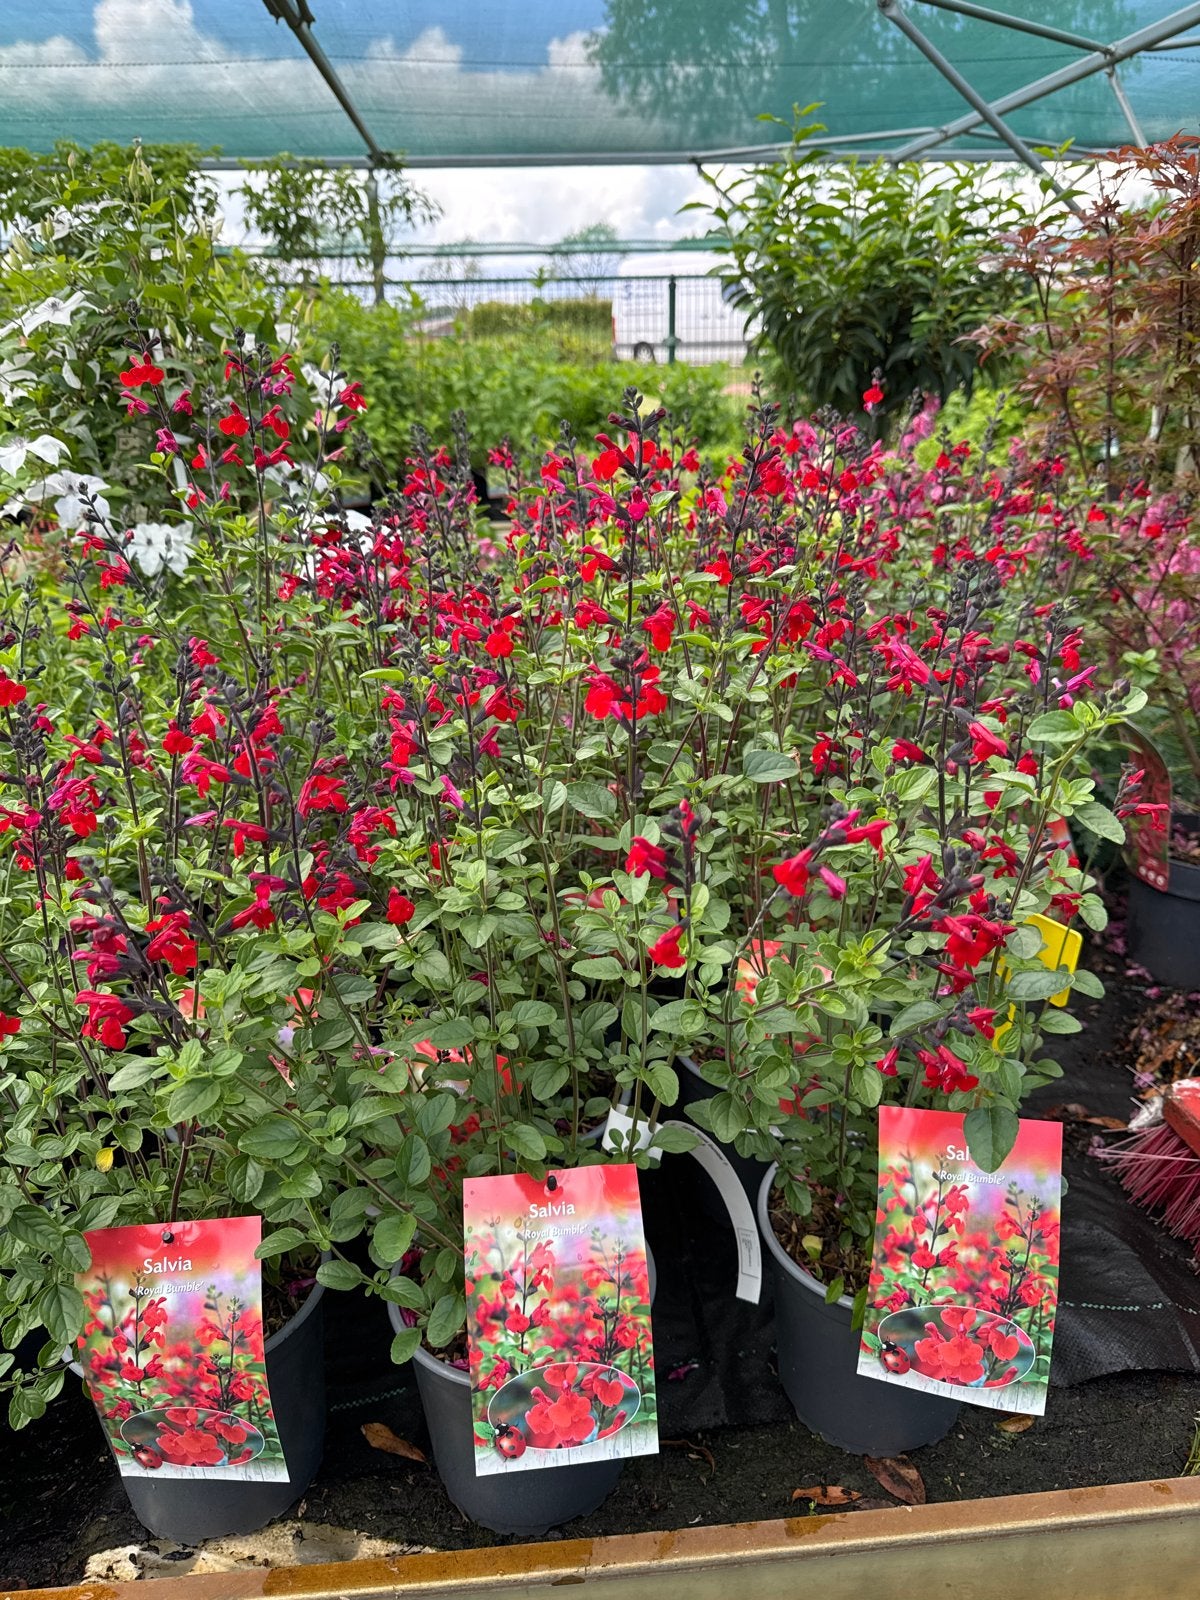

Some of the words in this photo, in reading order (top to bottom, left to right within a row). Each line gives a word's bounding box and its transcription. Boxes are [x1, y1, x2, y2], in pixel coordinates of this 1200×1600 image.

[946, 1144, 970, 1161] Sal
[529, 1201, 576, 1219] Salvia
[143, 1256, 193, 1275] Salvia
